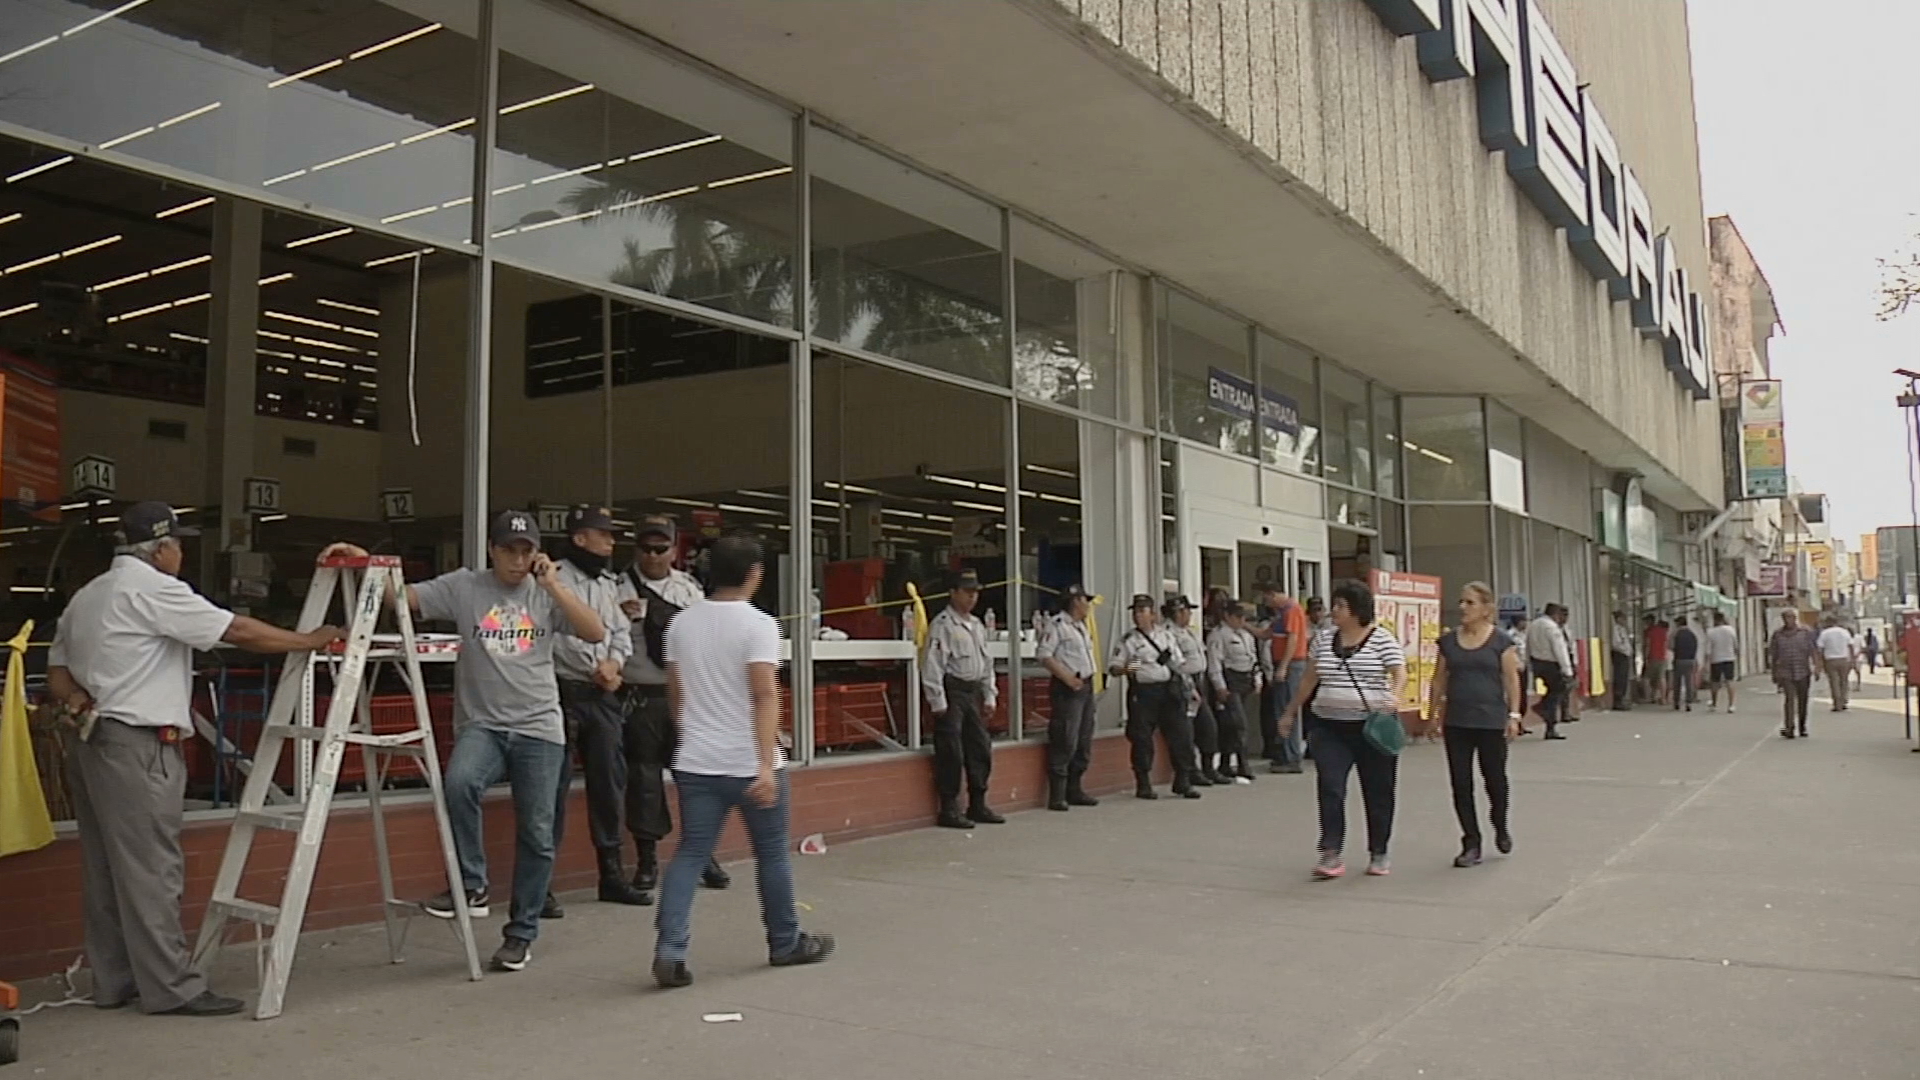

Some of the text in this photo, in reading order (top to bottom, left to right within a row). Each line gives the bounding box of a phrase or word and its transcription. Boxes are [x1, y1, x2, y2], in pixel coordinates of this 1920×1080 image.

[1380, 0, 1715, 392] HEDRAUI
[1209, 377, 1256, 414] ENTRADA
[1259, 397, 1298, 425] ENTRADA
[94, 463, 110, 488] 14
[255, 485, 274, 506] 13
[391, 494, 409, 515] 12
[510, 516, 527, 532] NY
[546, 513, 562, 531] 11
[472, 624, 546, 641] Panama
